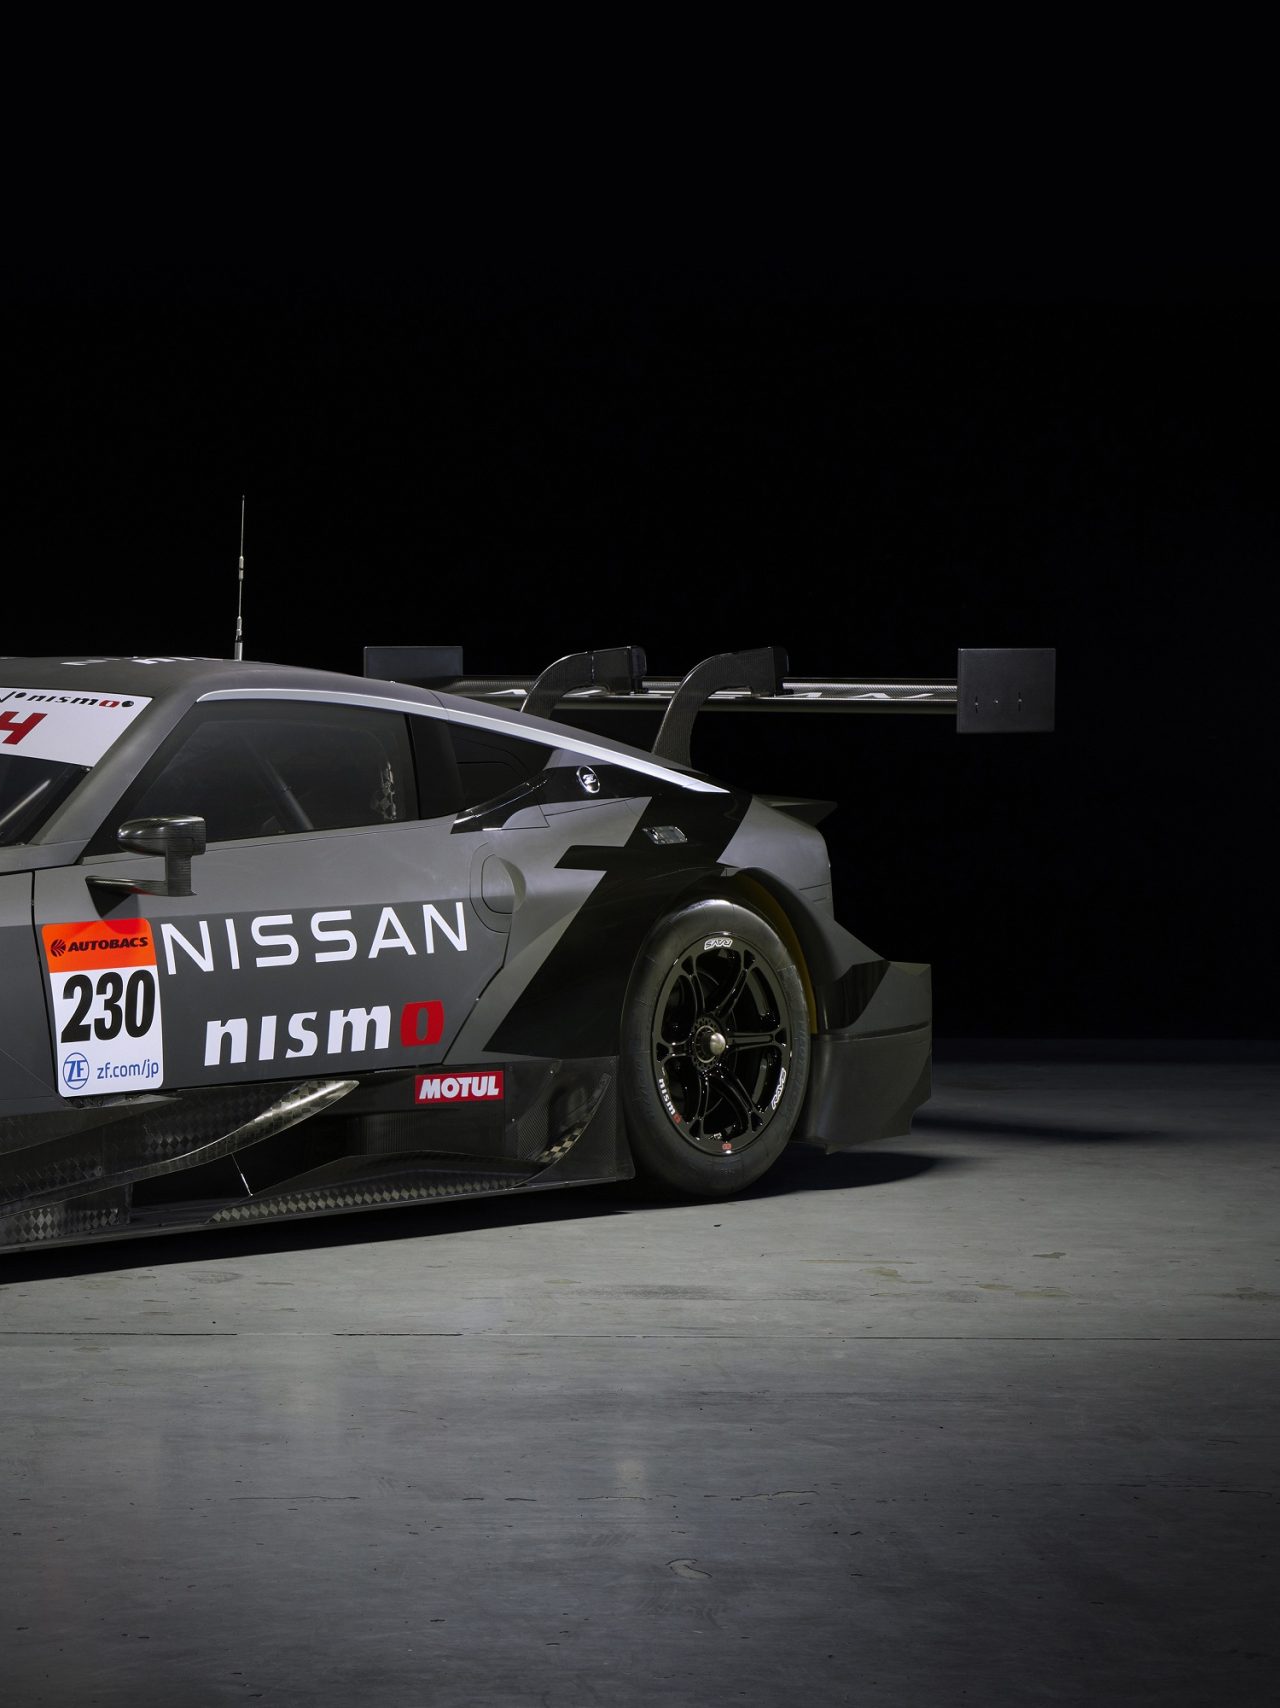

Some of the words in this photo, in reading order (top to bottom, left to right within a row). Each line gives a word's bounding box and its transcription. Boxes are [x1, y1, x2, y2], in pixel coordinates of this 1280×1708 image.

[27, 694, 120, 708] nismo
[68, 937, 148, 952] AUTOBACS
[160, 901, 468, 975] NISSAN
[60, 969, 155, 1043] 230
[204, 1000, 444, 1067] nismo
[97, 1059, 159, 1080] zf.com/jp
[419, 1076, 499, 1100] MOTUL
[659, 1079, 681, 1125] nismo
